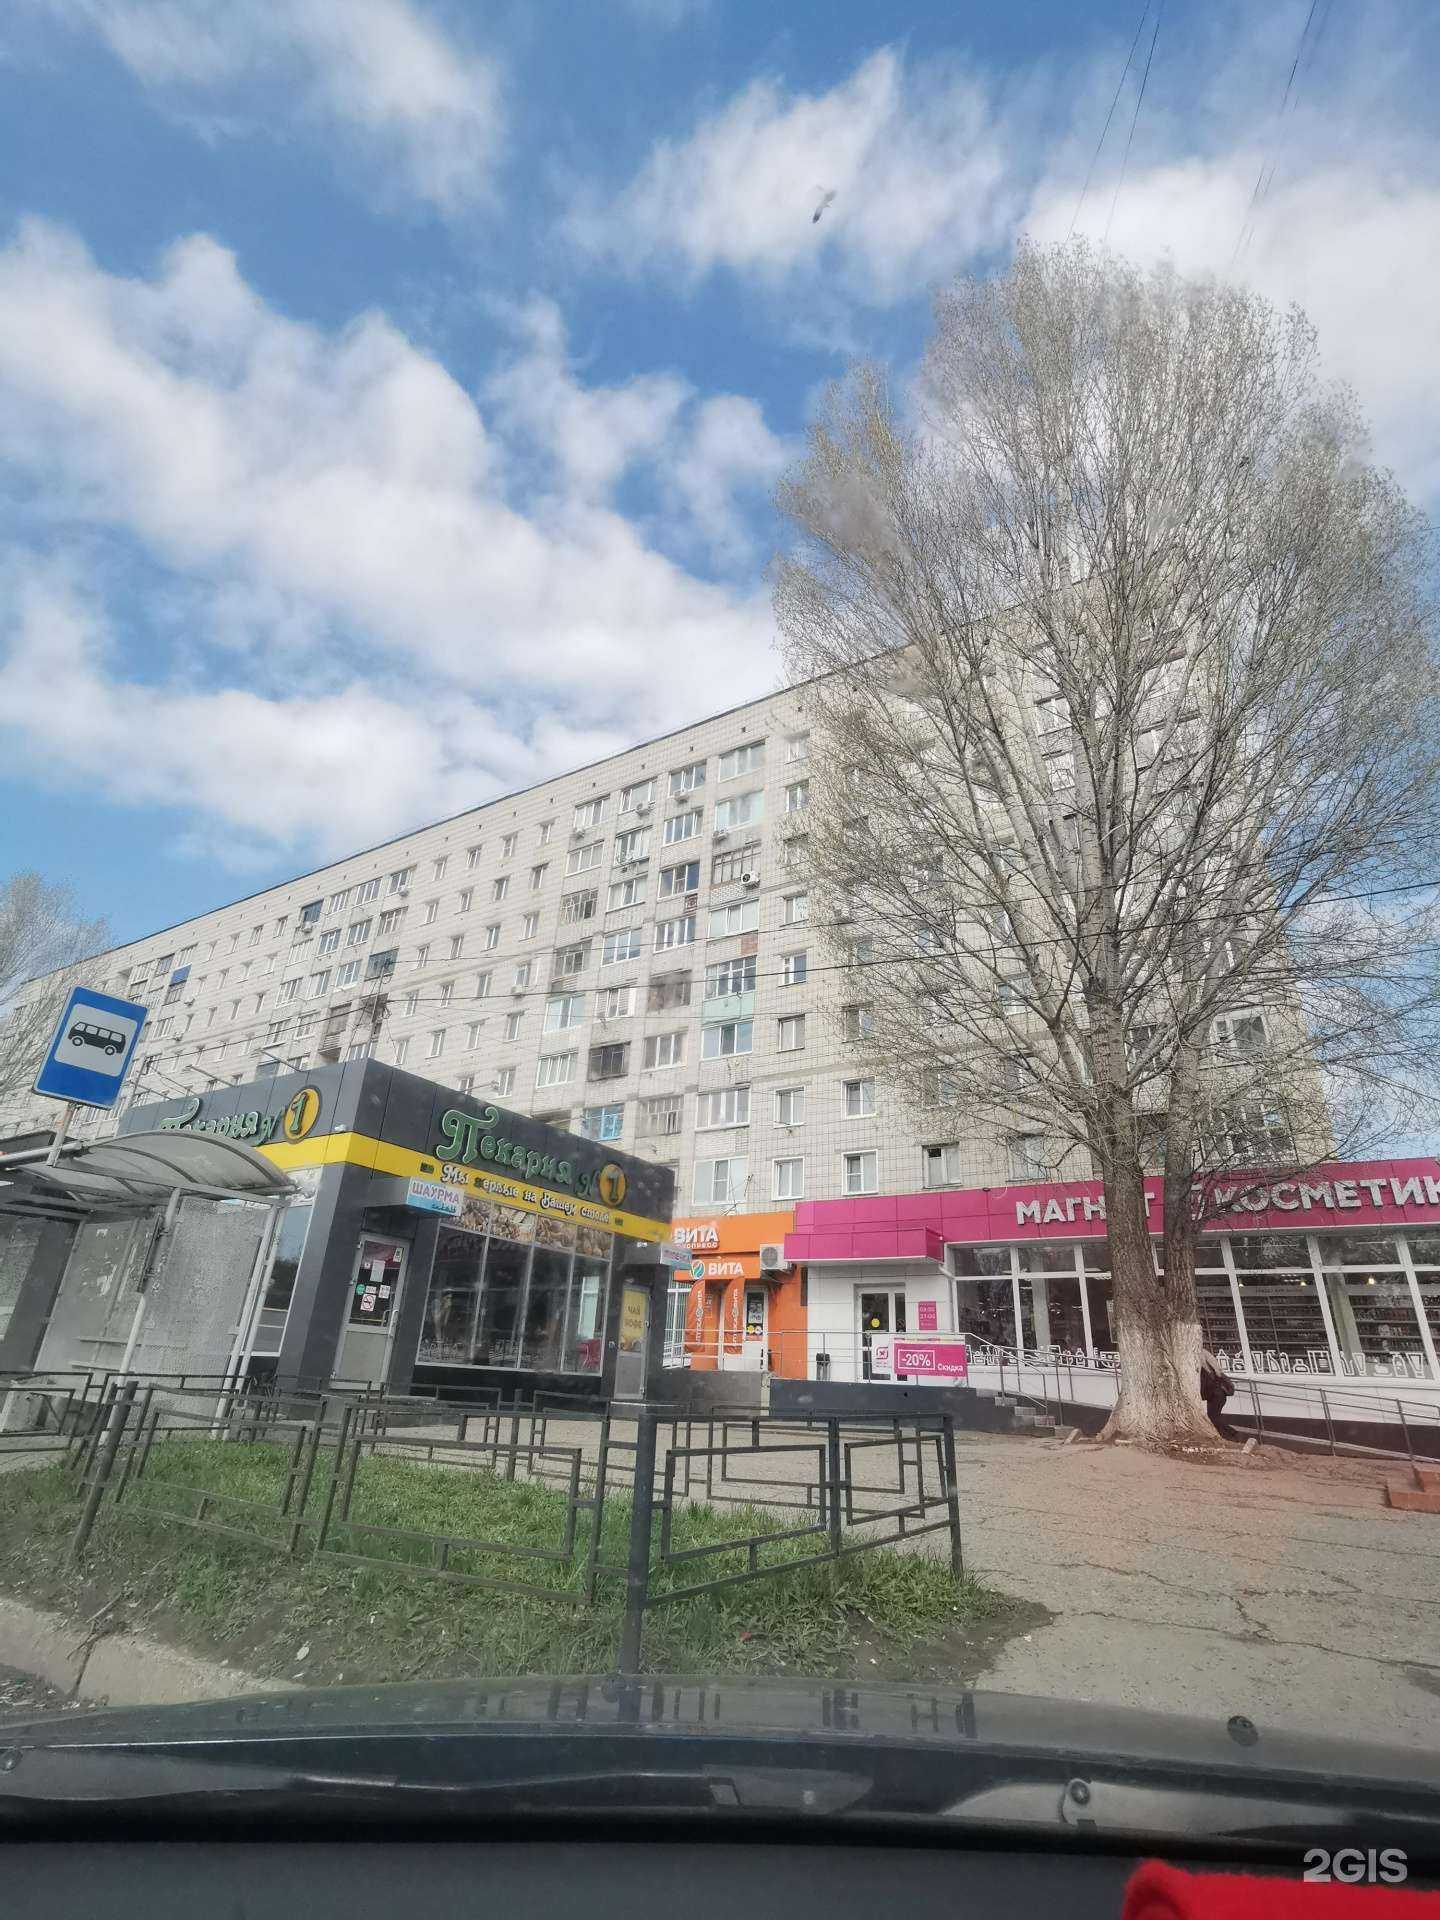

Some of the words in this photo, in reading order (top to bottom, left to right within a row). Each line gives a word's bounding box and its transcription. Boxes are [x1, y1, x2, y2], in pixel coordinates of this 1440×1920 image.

[436, 1107, 573, 1185] Пекарня
[412, 1181, 460, 1204] ШАУРМА
[441, 1163, 469, 1184] Мы
[474, 1177, 519, 1199] ервые
[524, 1190, 537, 1203] на
[541, 1192, 577, 1216] Вашем
[1015, 1192, 1155, 1225] МАГНТ
[674, 1226, 719, 1243] ВИТА
[708, 1262, 744, 1275] ВИТА
[901, 1353, 931, 1367] -20%
[937, 1363, 964, 1373] Скидка
